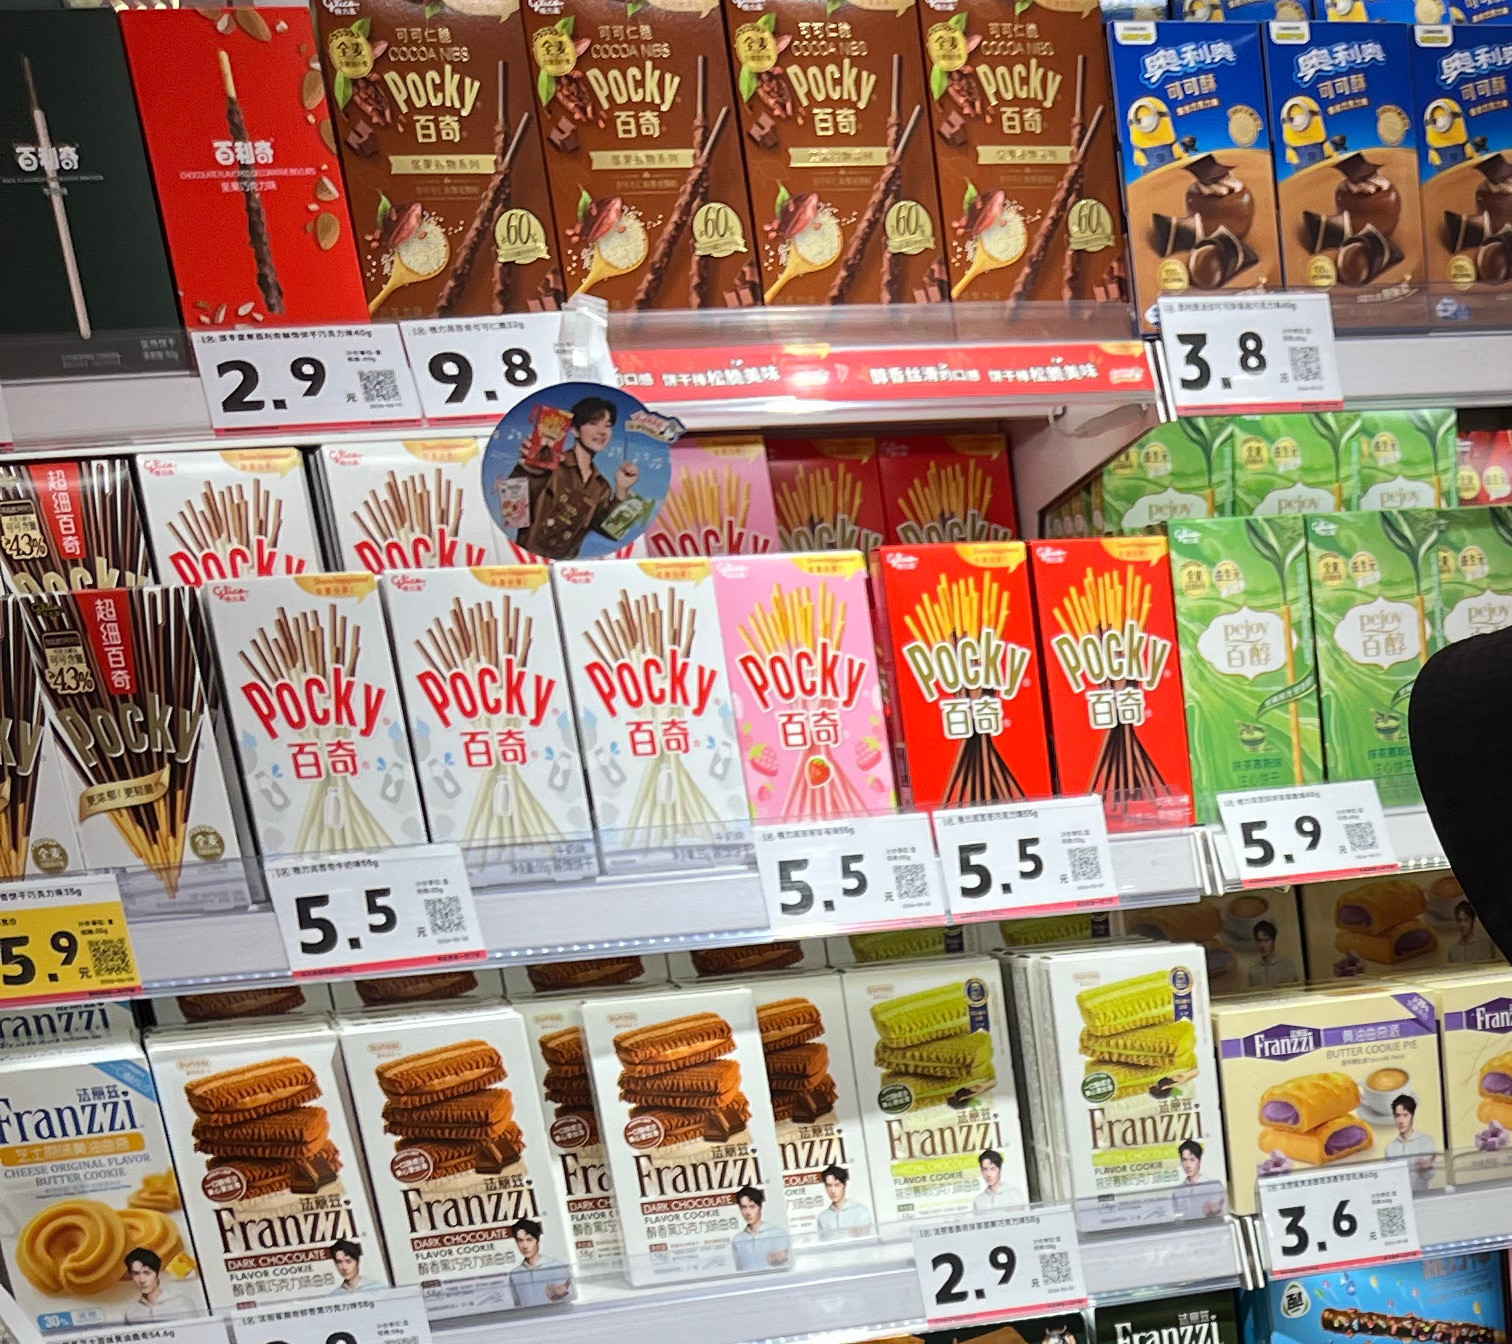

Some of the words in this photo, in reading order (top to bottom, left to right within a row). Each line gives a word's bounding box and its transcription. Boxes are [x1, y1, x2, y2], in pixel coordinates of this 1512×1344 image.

[975, 59, 1063, 108] Pocky
[1143, 42, 1238, 82] 奥利奥
[388, 65, 481, 117] Pocky
[414, 115, 461, 144] 百奇
[1000, 106, 1044, 135] 百奇
[217, 357, 327, 413] 2.9
[428, 347, 538, 405] 9.8
[1177, 332, 1267, 389] 3.8
[738, 640, 870, 713] Pocky
[902, 628, 1030, 701] Pocky
[241, 666, 386, 740] Pocky
[942, 697, 1004, 739] 百奇
[53, 693, 203, 769] Pocky
[778, 709, 842, 750] 百奇
[287, 742, 358, 780] 百奇
[957, 836, 1044, 899] 5.5
[1242, 815, 1322, 868] 5.9
[777, 853, 869, 915] 5.5
[295, 887, 397, 954] 5.5
[0, 931, 79, 984] 5.9
[1327, 1047, 1362, 1060] BUTTER
[1365, 1044, 1400, 1056] COOKIE
[1403, 1040, 1417, 1051] PIE
[888, 1115, 1004, 1161] Franzzi
[35, 1174, 76, 1188] BUTTER
[78, 1168, 126, 1186] COOKIE
[213, 1202, 360, 1254] Franzzi
[1278, 1199, 1358, 1257] 3.6
[228, 1257, 257, 1271] DARK
[260, 1248, 327, 1268] CHOCOLATE
[230, 1269, 270, 1281] FLAVOR
[272, 1264, 314, 1276] COOKIE
[932, 1246, 1017, 1305] 2.9
